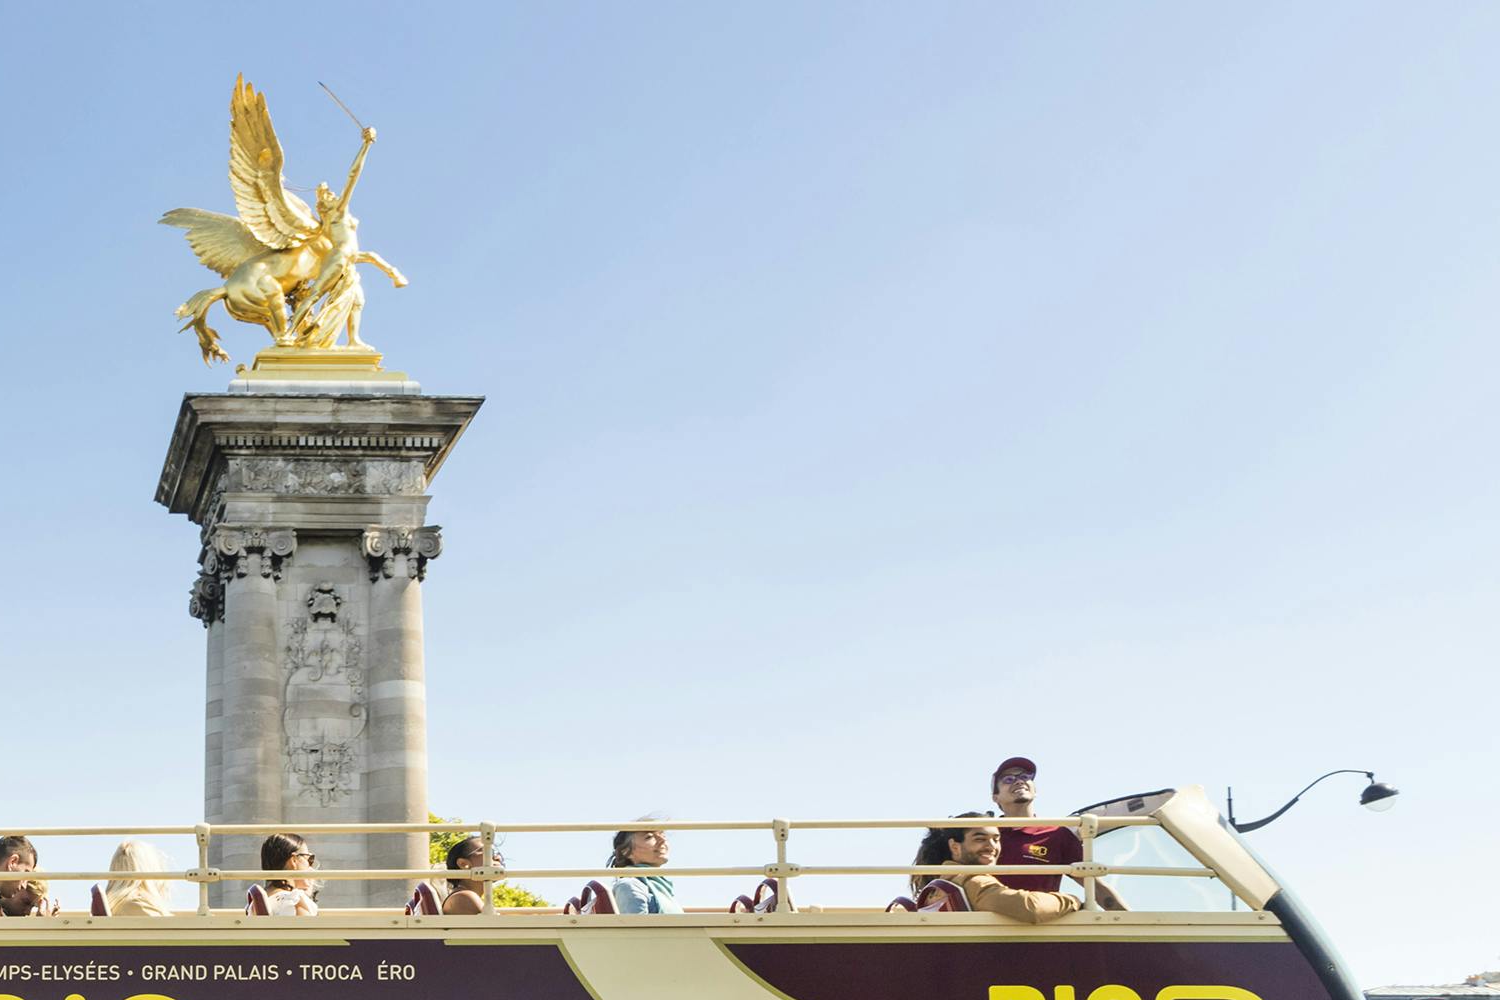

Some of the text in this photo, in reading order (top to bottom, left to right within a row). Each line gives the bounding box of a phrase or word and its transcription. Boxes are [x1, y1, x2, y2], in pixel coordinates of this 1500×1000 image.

[141, 964, 207, 980] GRAND
[213, 964, 279, 980] PALAIS
[299, 960, 415, 980] TROCAÉRO
